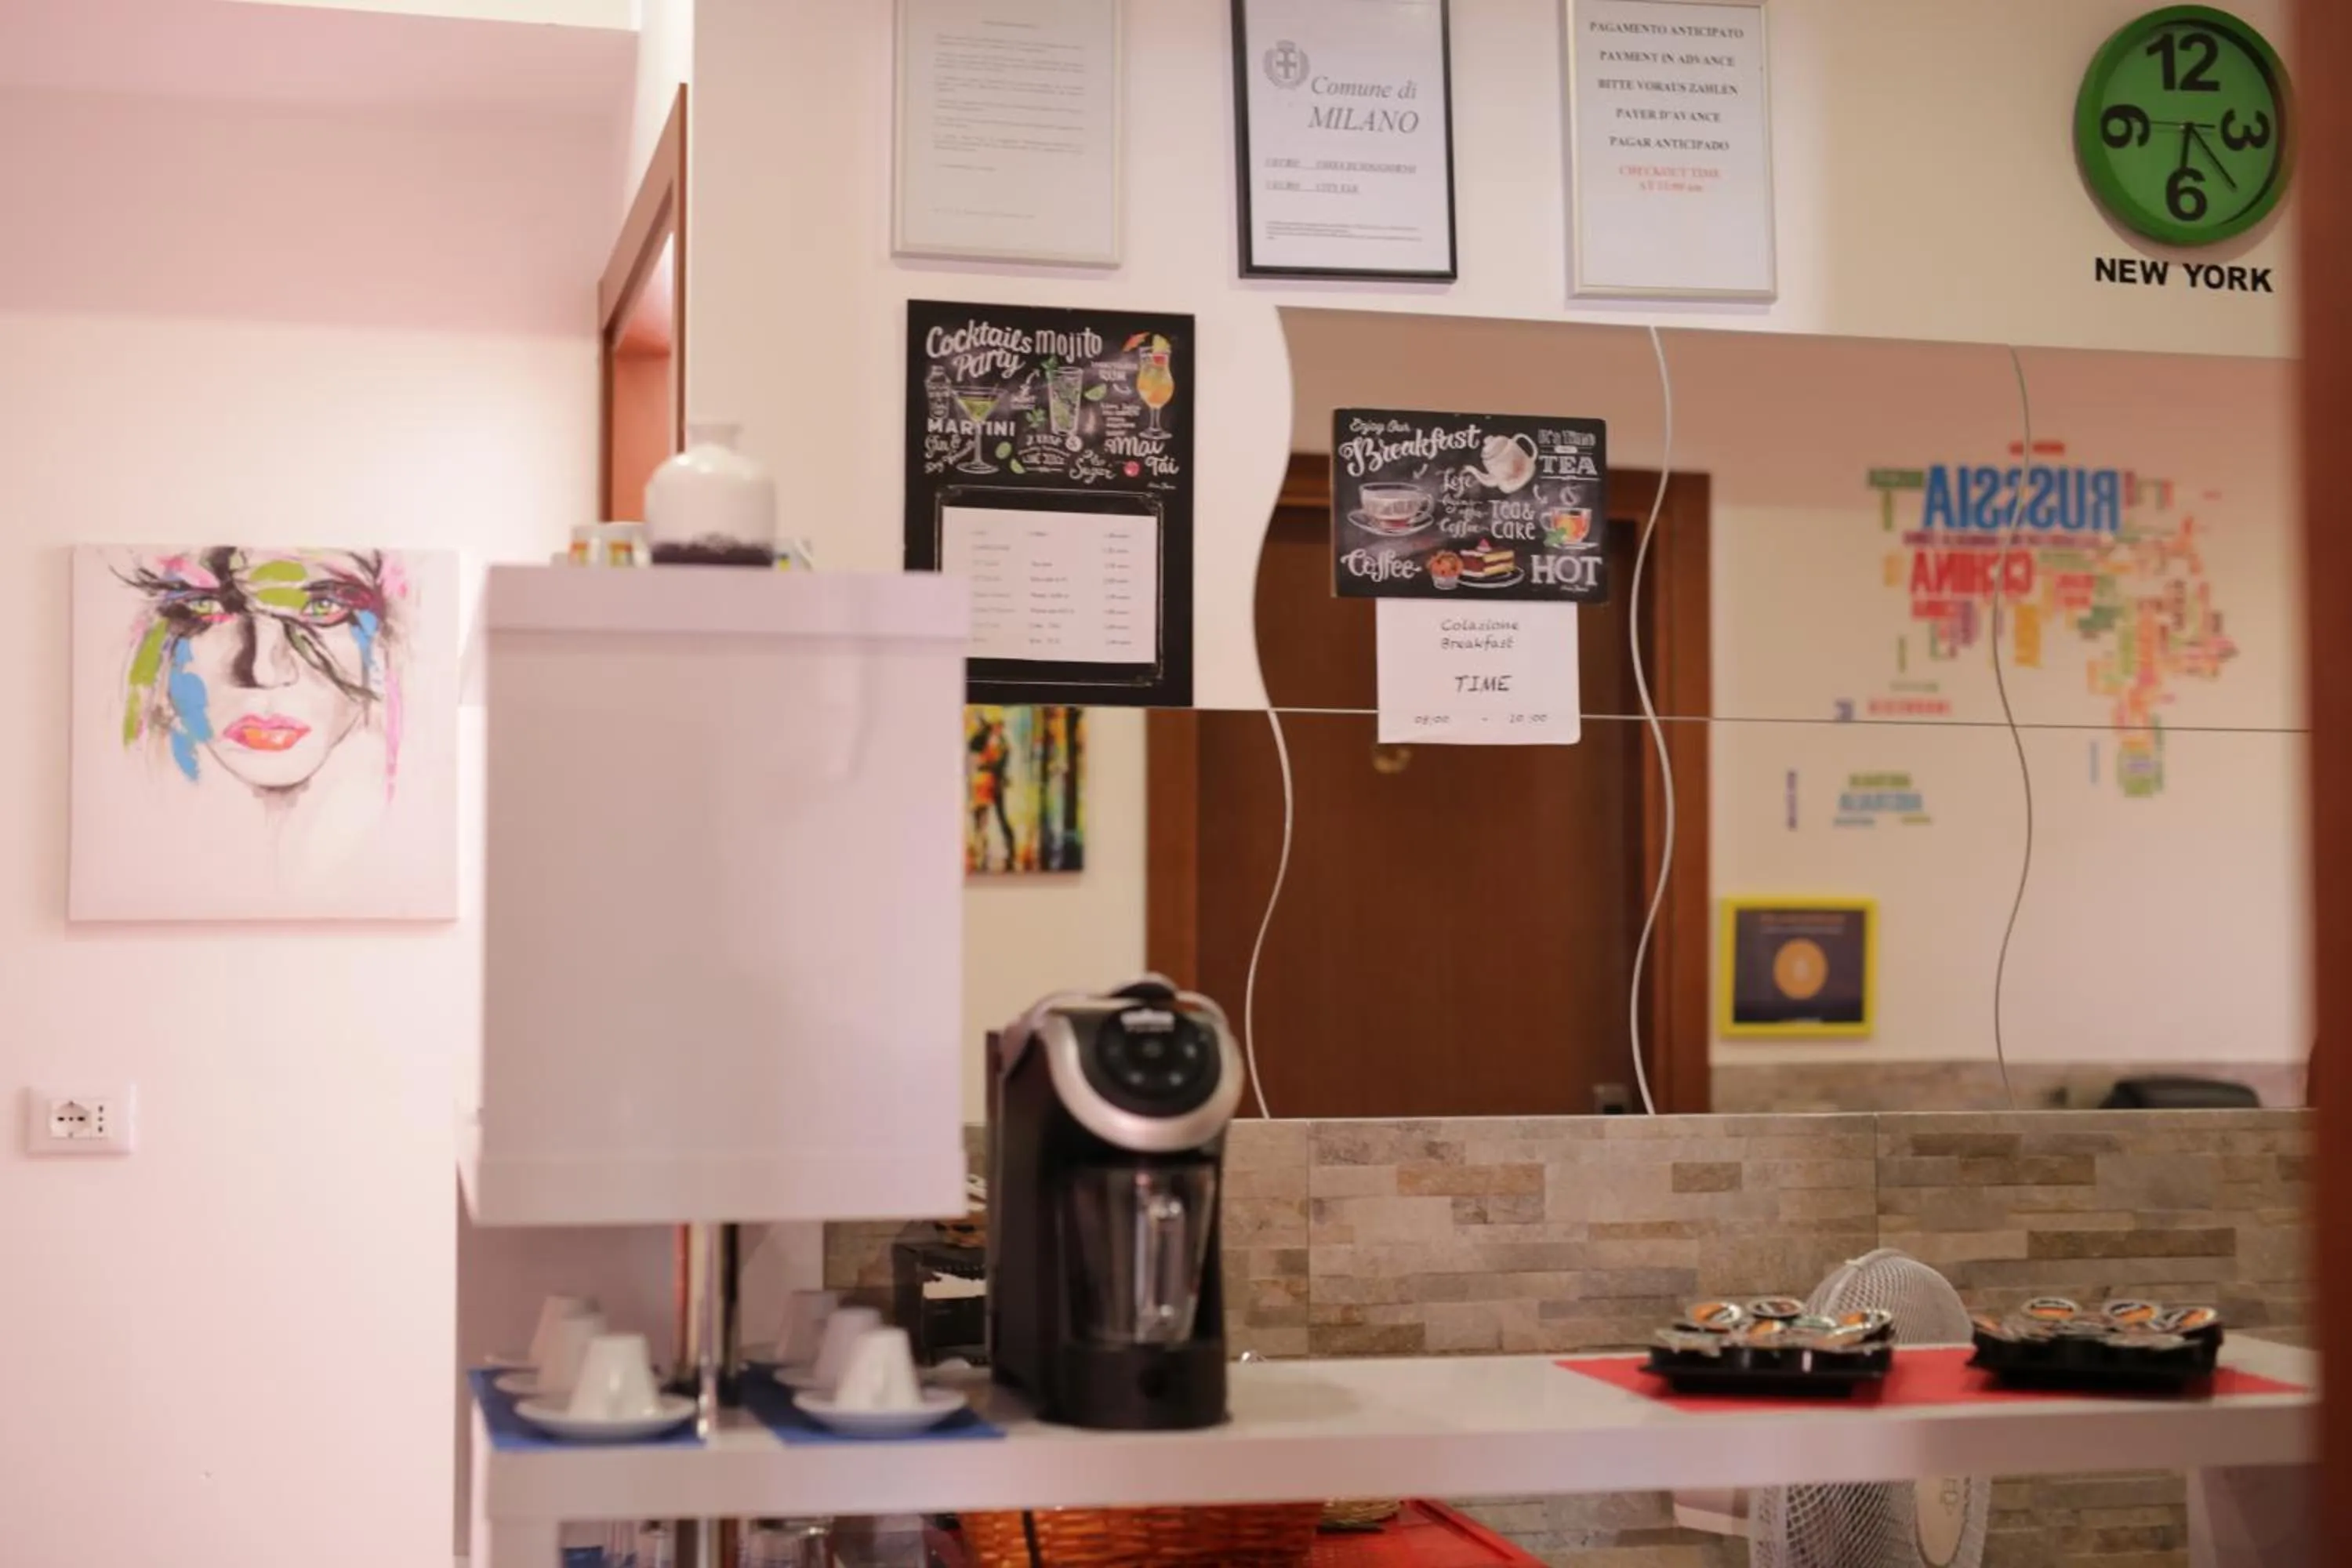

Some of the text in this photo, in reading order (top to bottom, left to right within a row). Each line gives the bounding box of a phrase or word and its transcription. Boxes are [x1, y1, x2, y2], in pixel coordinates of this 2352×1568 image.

[1589, 21, 1744, 39] PAGAMENTO ANTICIPATO
[1599, 50, 1735, 67] PAYMENT IN ADVANCE
[2147, 33, 2220, 92] 12
[1310, 75, 1417, 100] Comune di
[1598, 78, 1633, 91] BITTE
[1688, 82, 1739, 95] ZAHLEN
[1307, 106, 1420, 134] MILANO
[1616, 108, 1657, 121] PAYER
[2220, 107, 2270, 151] 3
[1609, 136, 1730, 151] PAGAR ANTICIPADO
[2165, 167, 2208, 222] 6
[2096, 257, 2274, 293] NEW YORK
[926, 319, 1033, 358] Cocktails
[953, 350, 1025, 382] Party
[927, 417, 1017, 436] MARTINI
[1104, 437, 1164, 457] Mai
[1338, 423, 1483, 477] Breakfast
[1538, 455, 1598, 475] TEA
[1340, 548, 1423, 583] Coffee
[1530, 554, 1602, 586] HOT
[1440, 619, 1519, 632] Colazione
[1440, 634, 1515, 651] Breakfast
[1454, 674, 1513, 694] TIME
